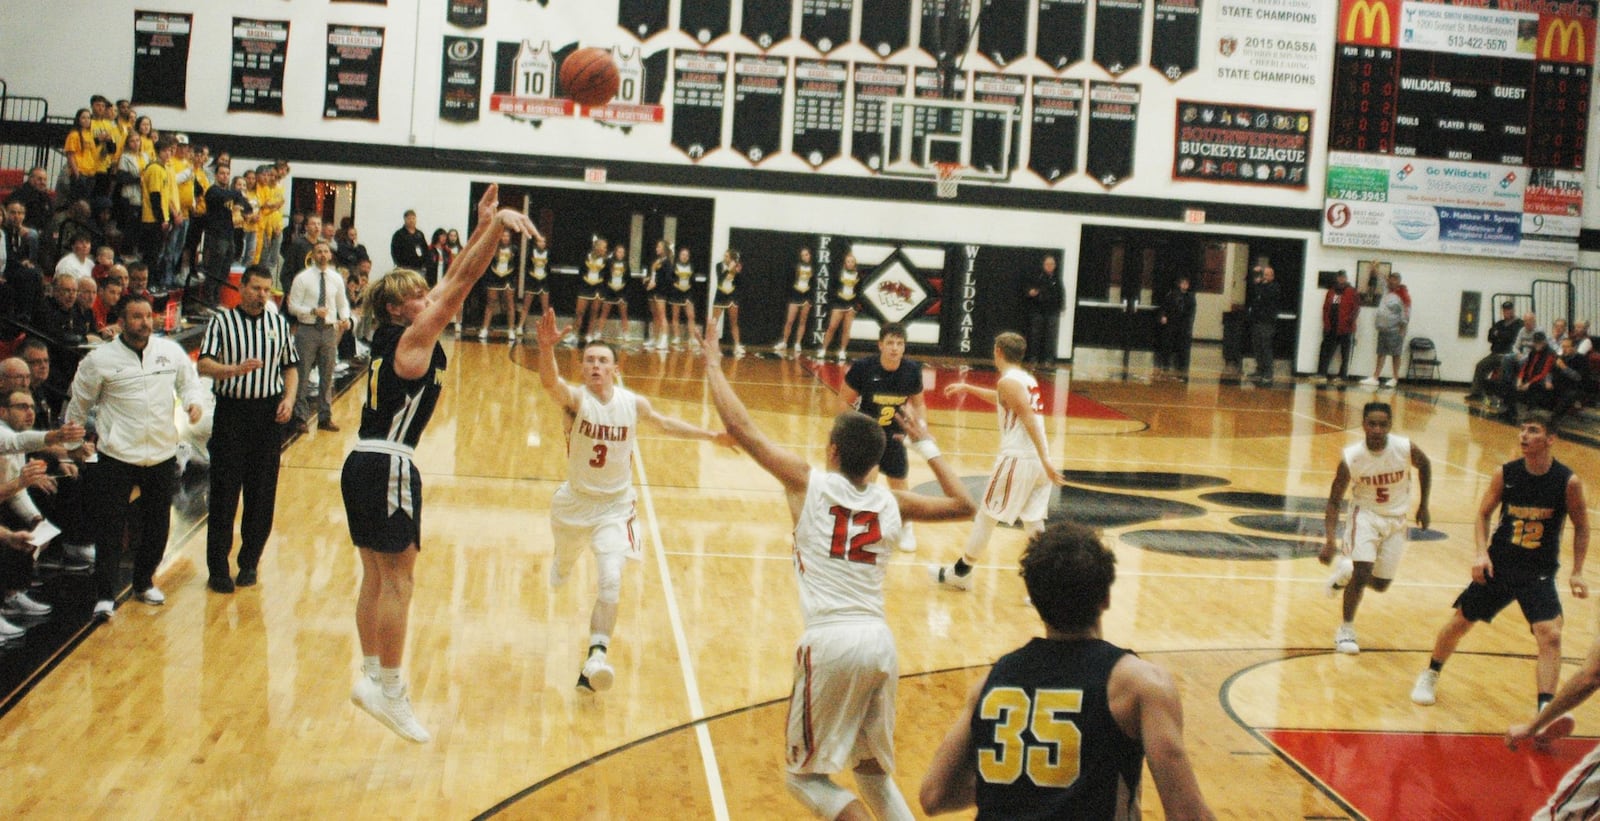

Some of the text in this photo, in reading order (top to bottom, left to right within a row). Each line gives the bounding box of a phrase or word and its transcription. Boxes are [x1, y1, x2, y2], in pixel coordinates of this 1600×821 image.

[1222, 6, 1317, 24] STATE CHAMPIONS
[1244, 37, 1317, 53] 2015 OASSA
[1448, 35, 1507, 50] 513-422-5570
[523, 71, 545, 94] 10
[1218, 67, 1316, 85] STATE CHAMPIONS
[1402, 77, 1526, 99] WILDCATS PERIOD GUEST
[1397, 116, 1419, 126] FOULS
[1439, 119, 1465, 130] PLAYER
[1505, 125, 1527, 135] FOULS
[1181, 141, 1305, 163] BUCKEYE LEAGUE
[1395, 146, 1523, 164] SCORE MATCH SCORE
[1426, 167, 1440, 176] Go
[1340, 190, 1386, 202] 746-3943
[1533, 215, 1545, 233] 9
[813, 236, 832, 345] FRANKLIN
[960, 245, 980, 353] WILDCATS
[878, 406, 895, 426] 2
[578, 419, 628, 441] FRANKLIN
[589, 444, 608, 469] 3
[1359, 470, 1404, 487] FRANKLIN
[1376, 487, 1390, 504] 5
[829, 504, 882, 565] 12
[1511, 519, 1544, 549] 12
[978, 686, 1083, 788] 35
